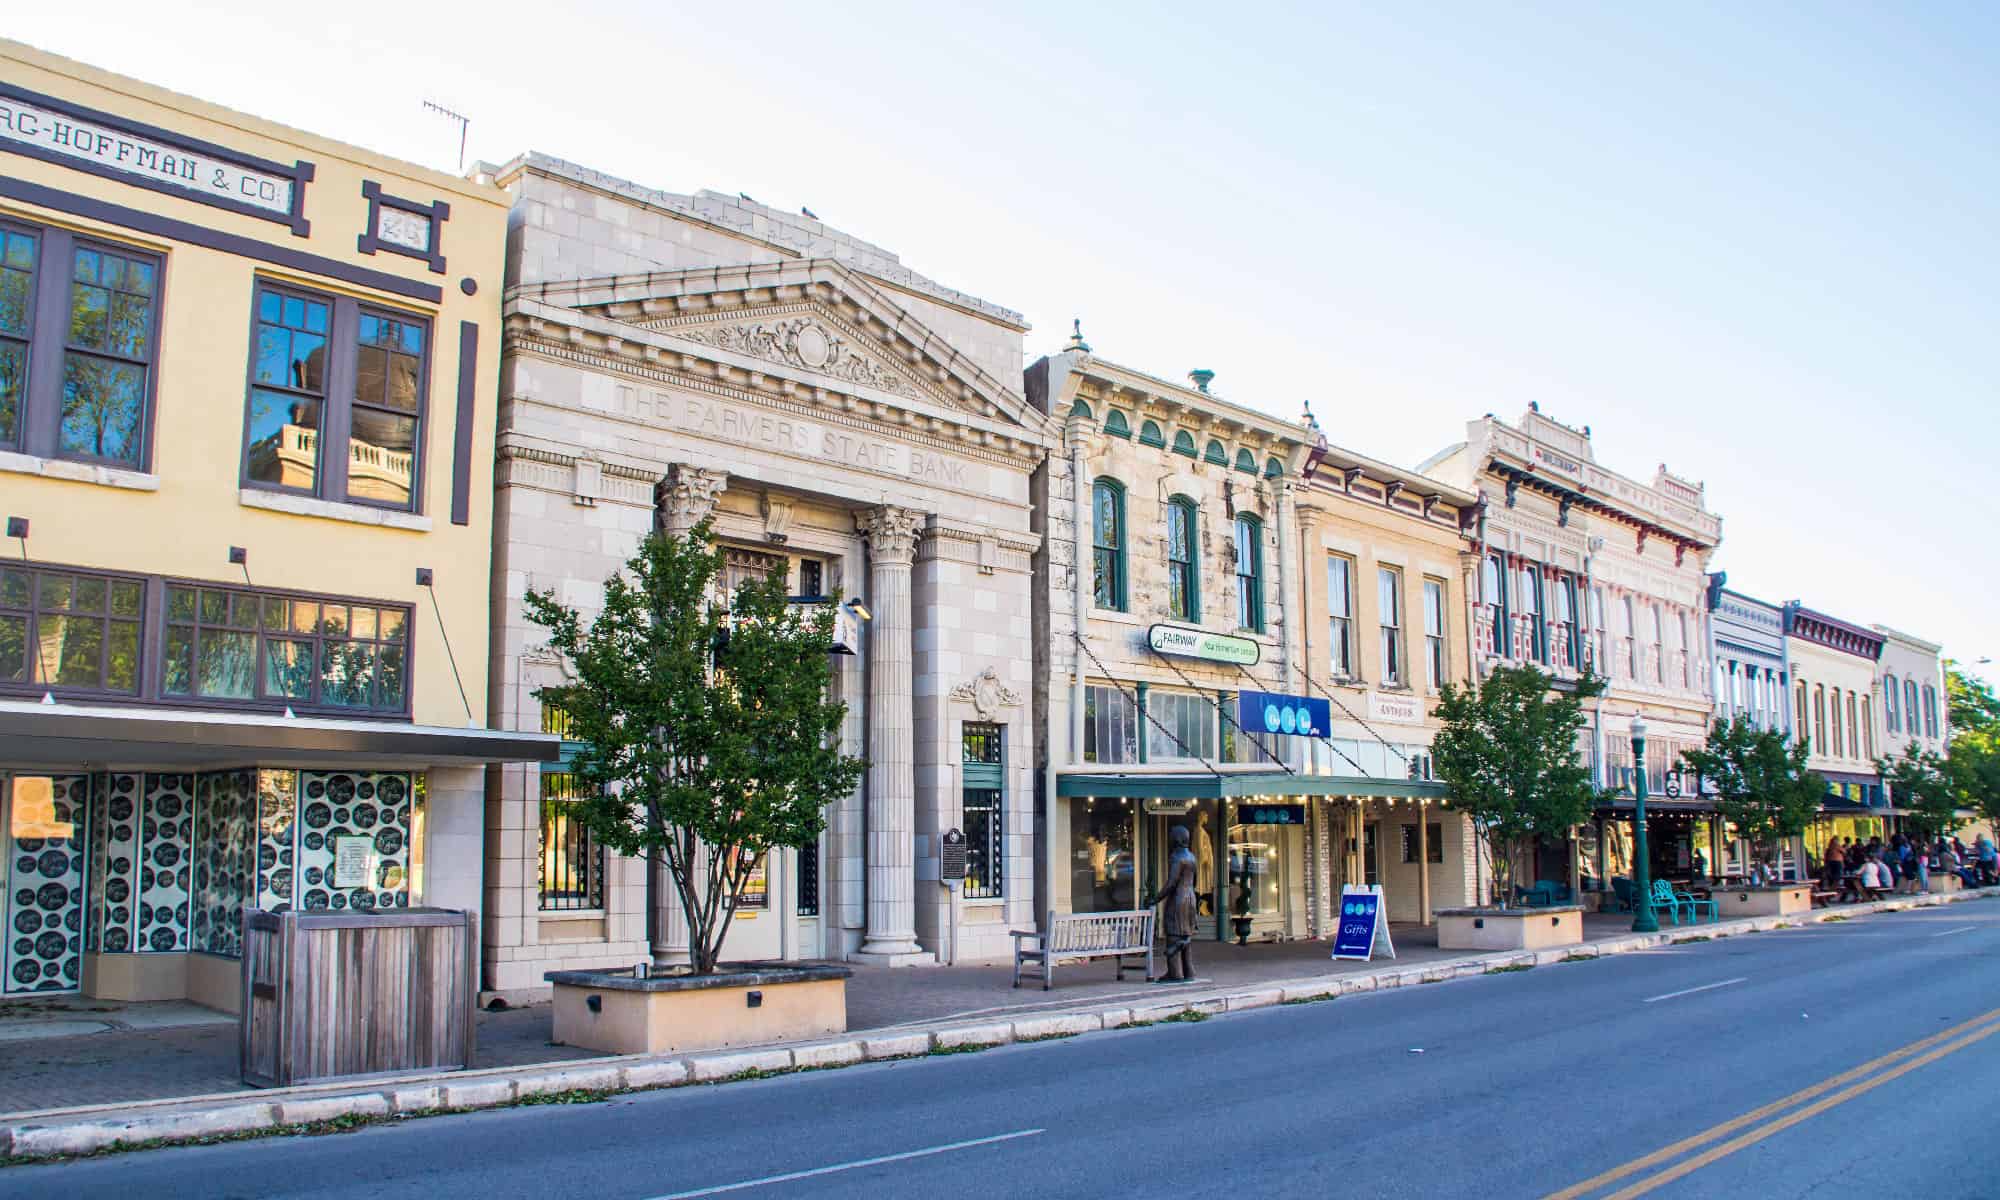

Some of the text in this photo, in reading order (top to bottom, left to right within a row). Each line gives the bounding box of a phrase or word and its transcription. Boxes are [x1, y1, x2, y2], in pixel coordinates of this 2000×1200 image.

[212, 169, 230, 190] &
[615, 385, 968, 486] THE FARMERS STATE BANK
[1163, 632, 1197, 647] FAIRWAY
[1344, 923, 1368, 936] Gifts
